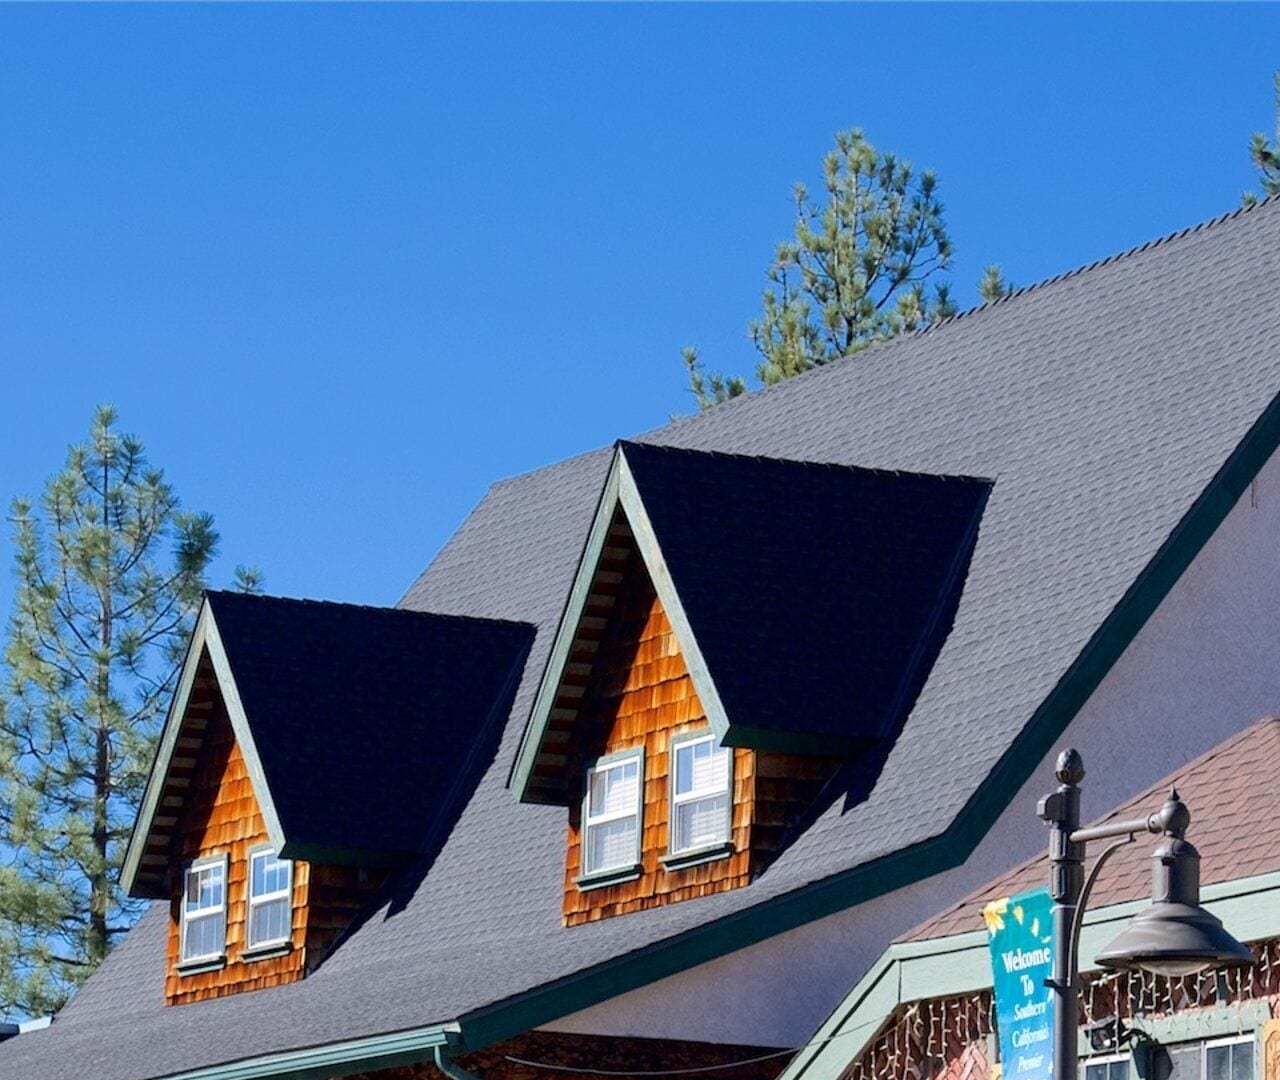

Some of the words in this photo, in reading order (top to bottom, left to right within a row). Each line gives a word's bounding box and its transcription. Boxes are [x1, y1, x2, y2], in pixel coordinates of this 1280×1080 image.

[1001, 948, 1051, 973] Welcome
[1020, 974, 1035, 997] To
[1014, 1000, 1047, 1021] Southern
